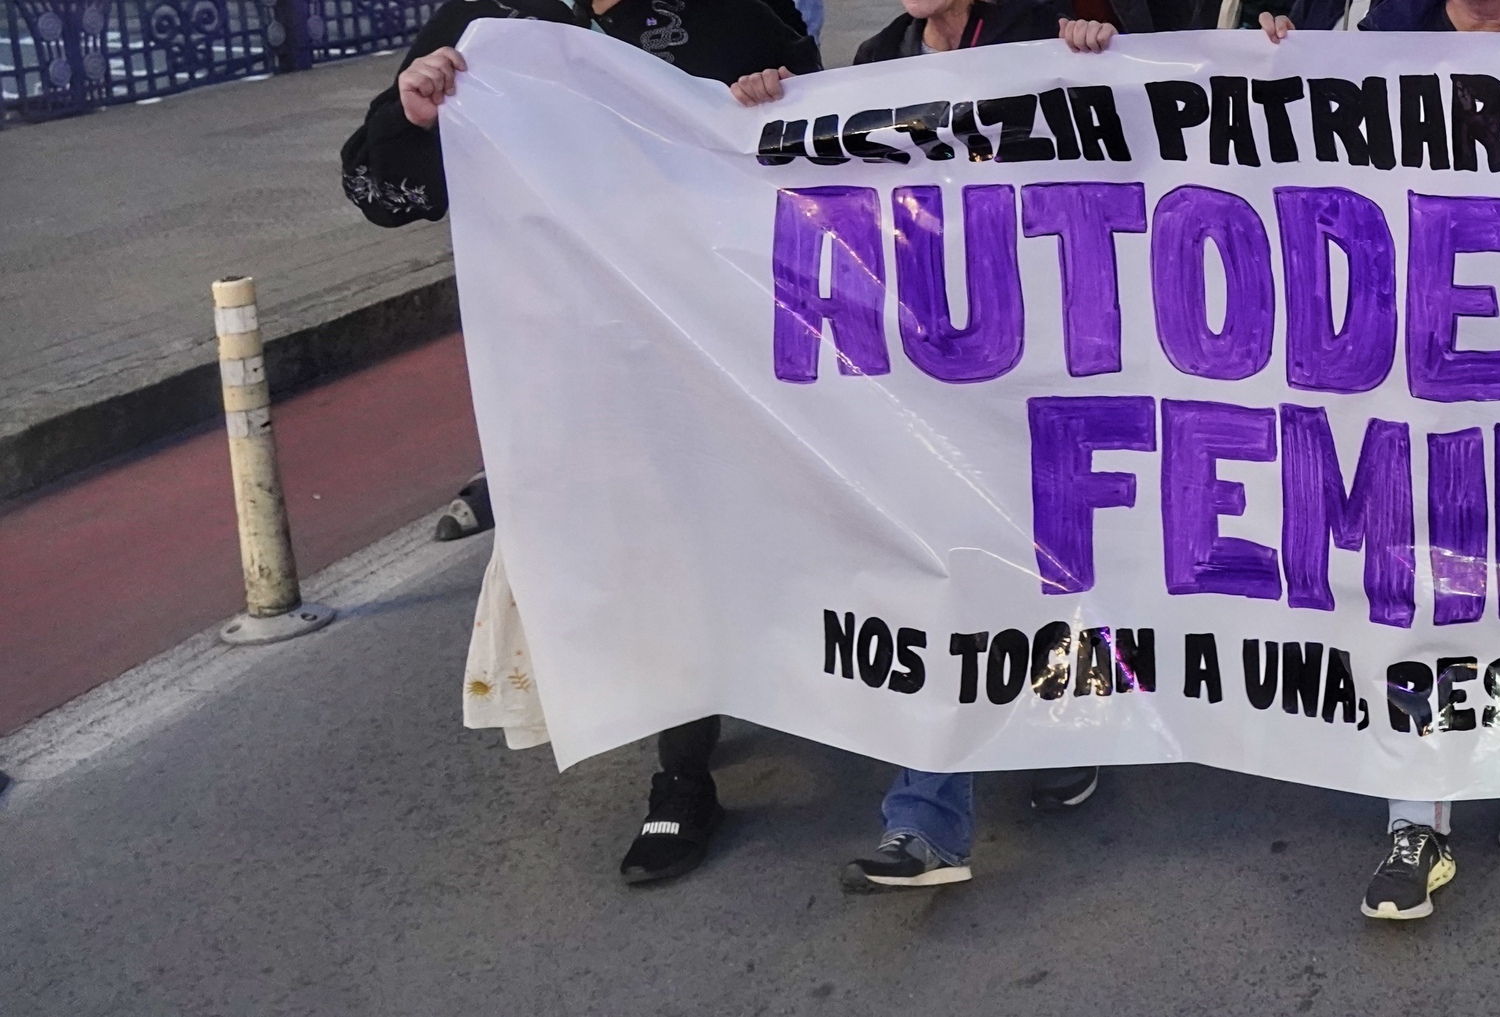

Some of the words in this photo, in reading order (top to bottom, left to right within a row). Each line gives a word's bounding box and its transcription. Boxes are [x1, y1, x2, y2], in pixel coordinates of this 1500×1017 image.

[824, 609, 927, 694] NOS
[950, 621, 1156, 705] TOCAN
[1184, 632, 1222, 703] A
[1243, 639, 1370, 731] UNA,
[641, 821, 680, 835] PUMA
